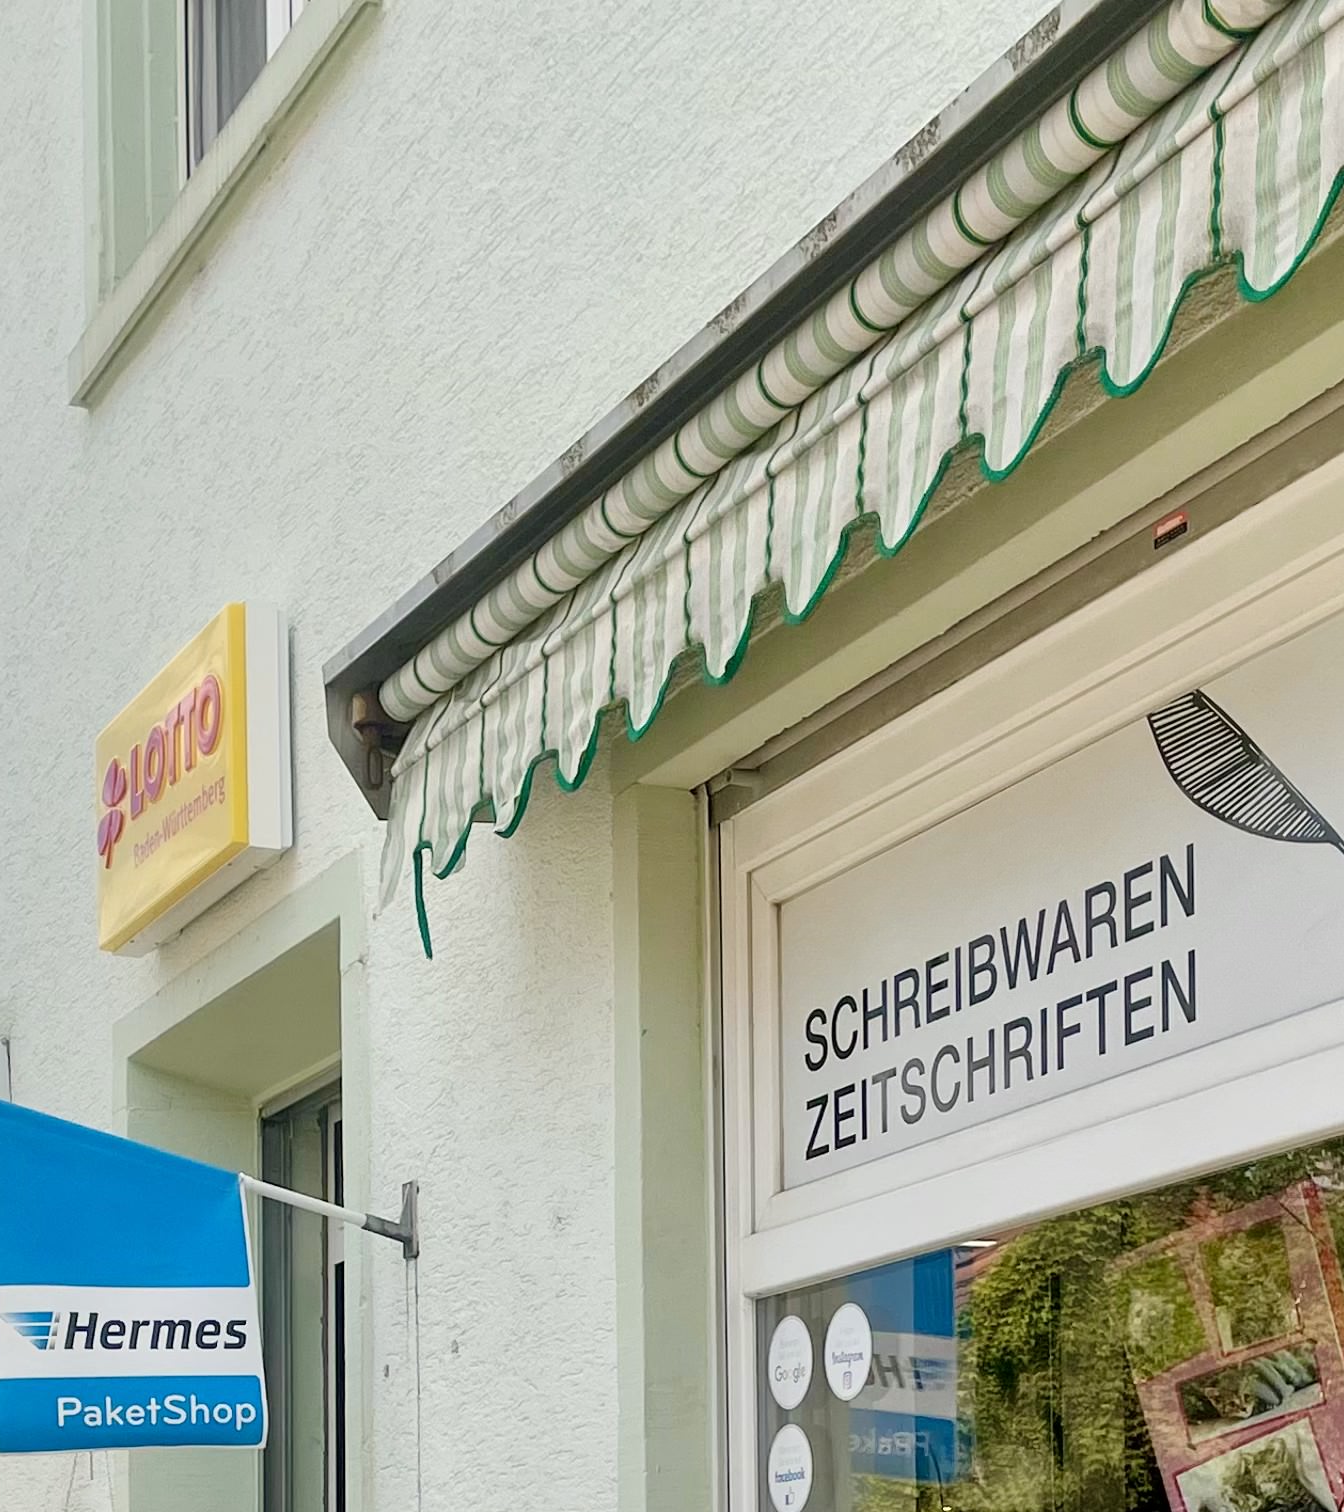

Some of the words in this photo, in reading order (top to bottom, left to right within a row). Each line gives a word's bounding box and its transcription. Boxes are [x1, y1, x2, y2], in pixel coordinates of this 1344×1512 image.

[130, 674, 222, 821] LOTTO
[134, 776, 226, 868] Baden-Württemberg
[804, 842, 1196, 1073] SCHREIBWAREN
[806, 949, 1197, 1161] ZEITSCHRIFTEN
[64, 1312, 247, 1351] Hermes
[57, 1394, 257, 1430] PaketShop
[774, 1467, 806, 1483] facebook
